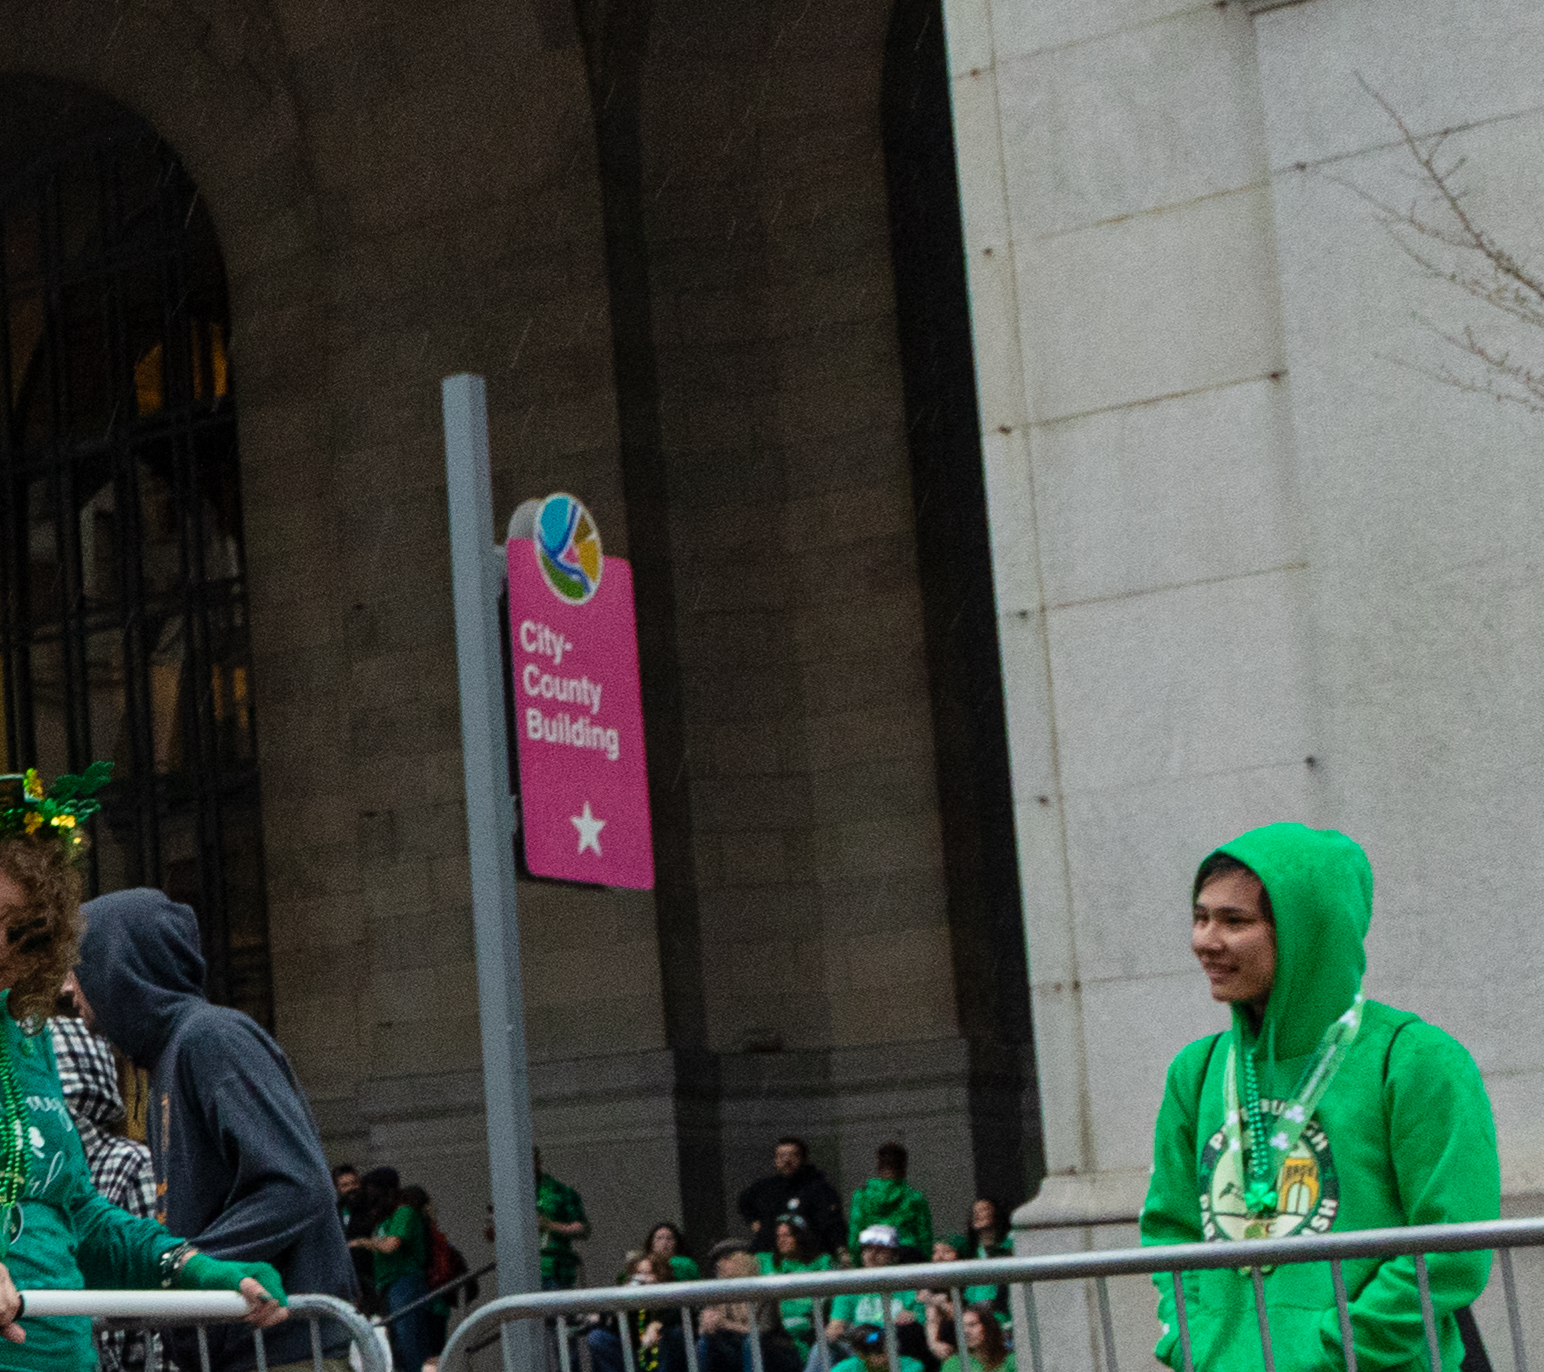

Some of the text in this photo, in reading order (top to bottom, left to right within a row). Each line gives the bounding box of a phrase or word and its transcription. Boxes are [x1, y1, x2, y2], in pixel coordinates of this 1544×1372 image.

[519, 619, 572, 665] City-
[523, 664, 602, 715] County
[526, 707, 620, 762] Building
